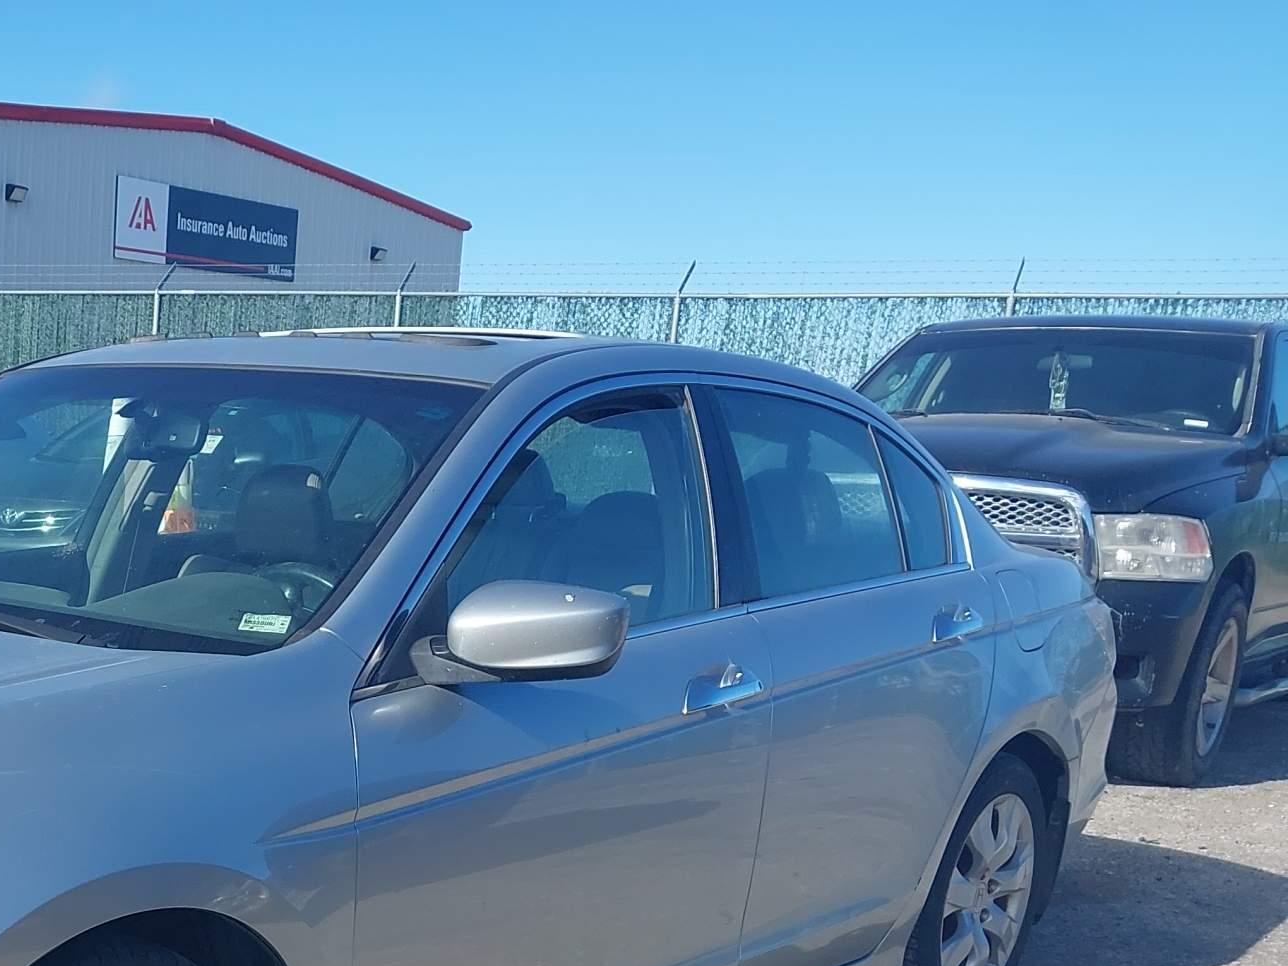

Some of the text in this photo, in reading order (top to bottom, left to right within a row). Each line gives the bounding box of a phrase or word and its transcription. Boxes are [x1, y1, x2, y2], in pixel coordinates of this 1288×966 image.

[176, 212, 288, 248] Insurance Auto Auctions
